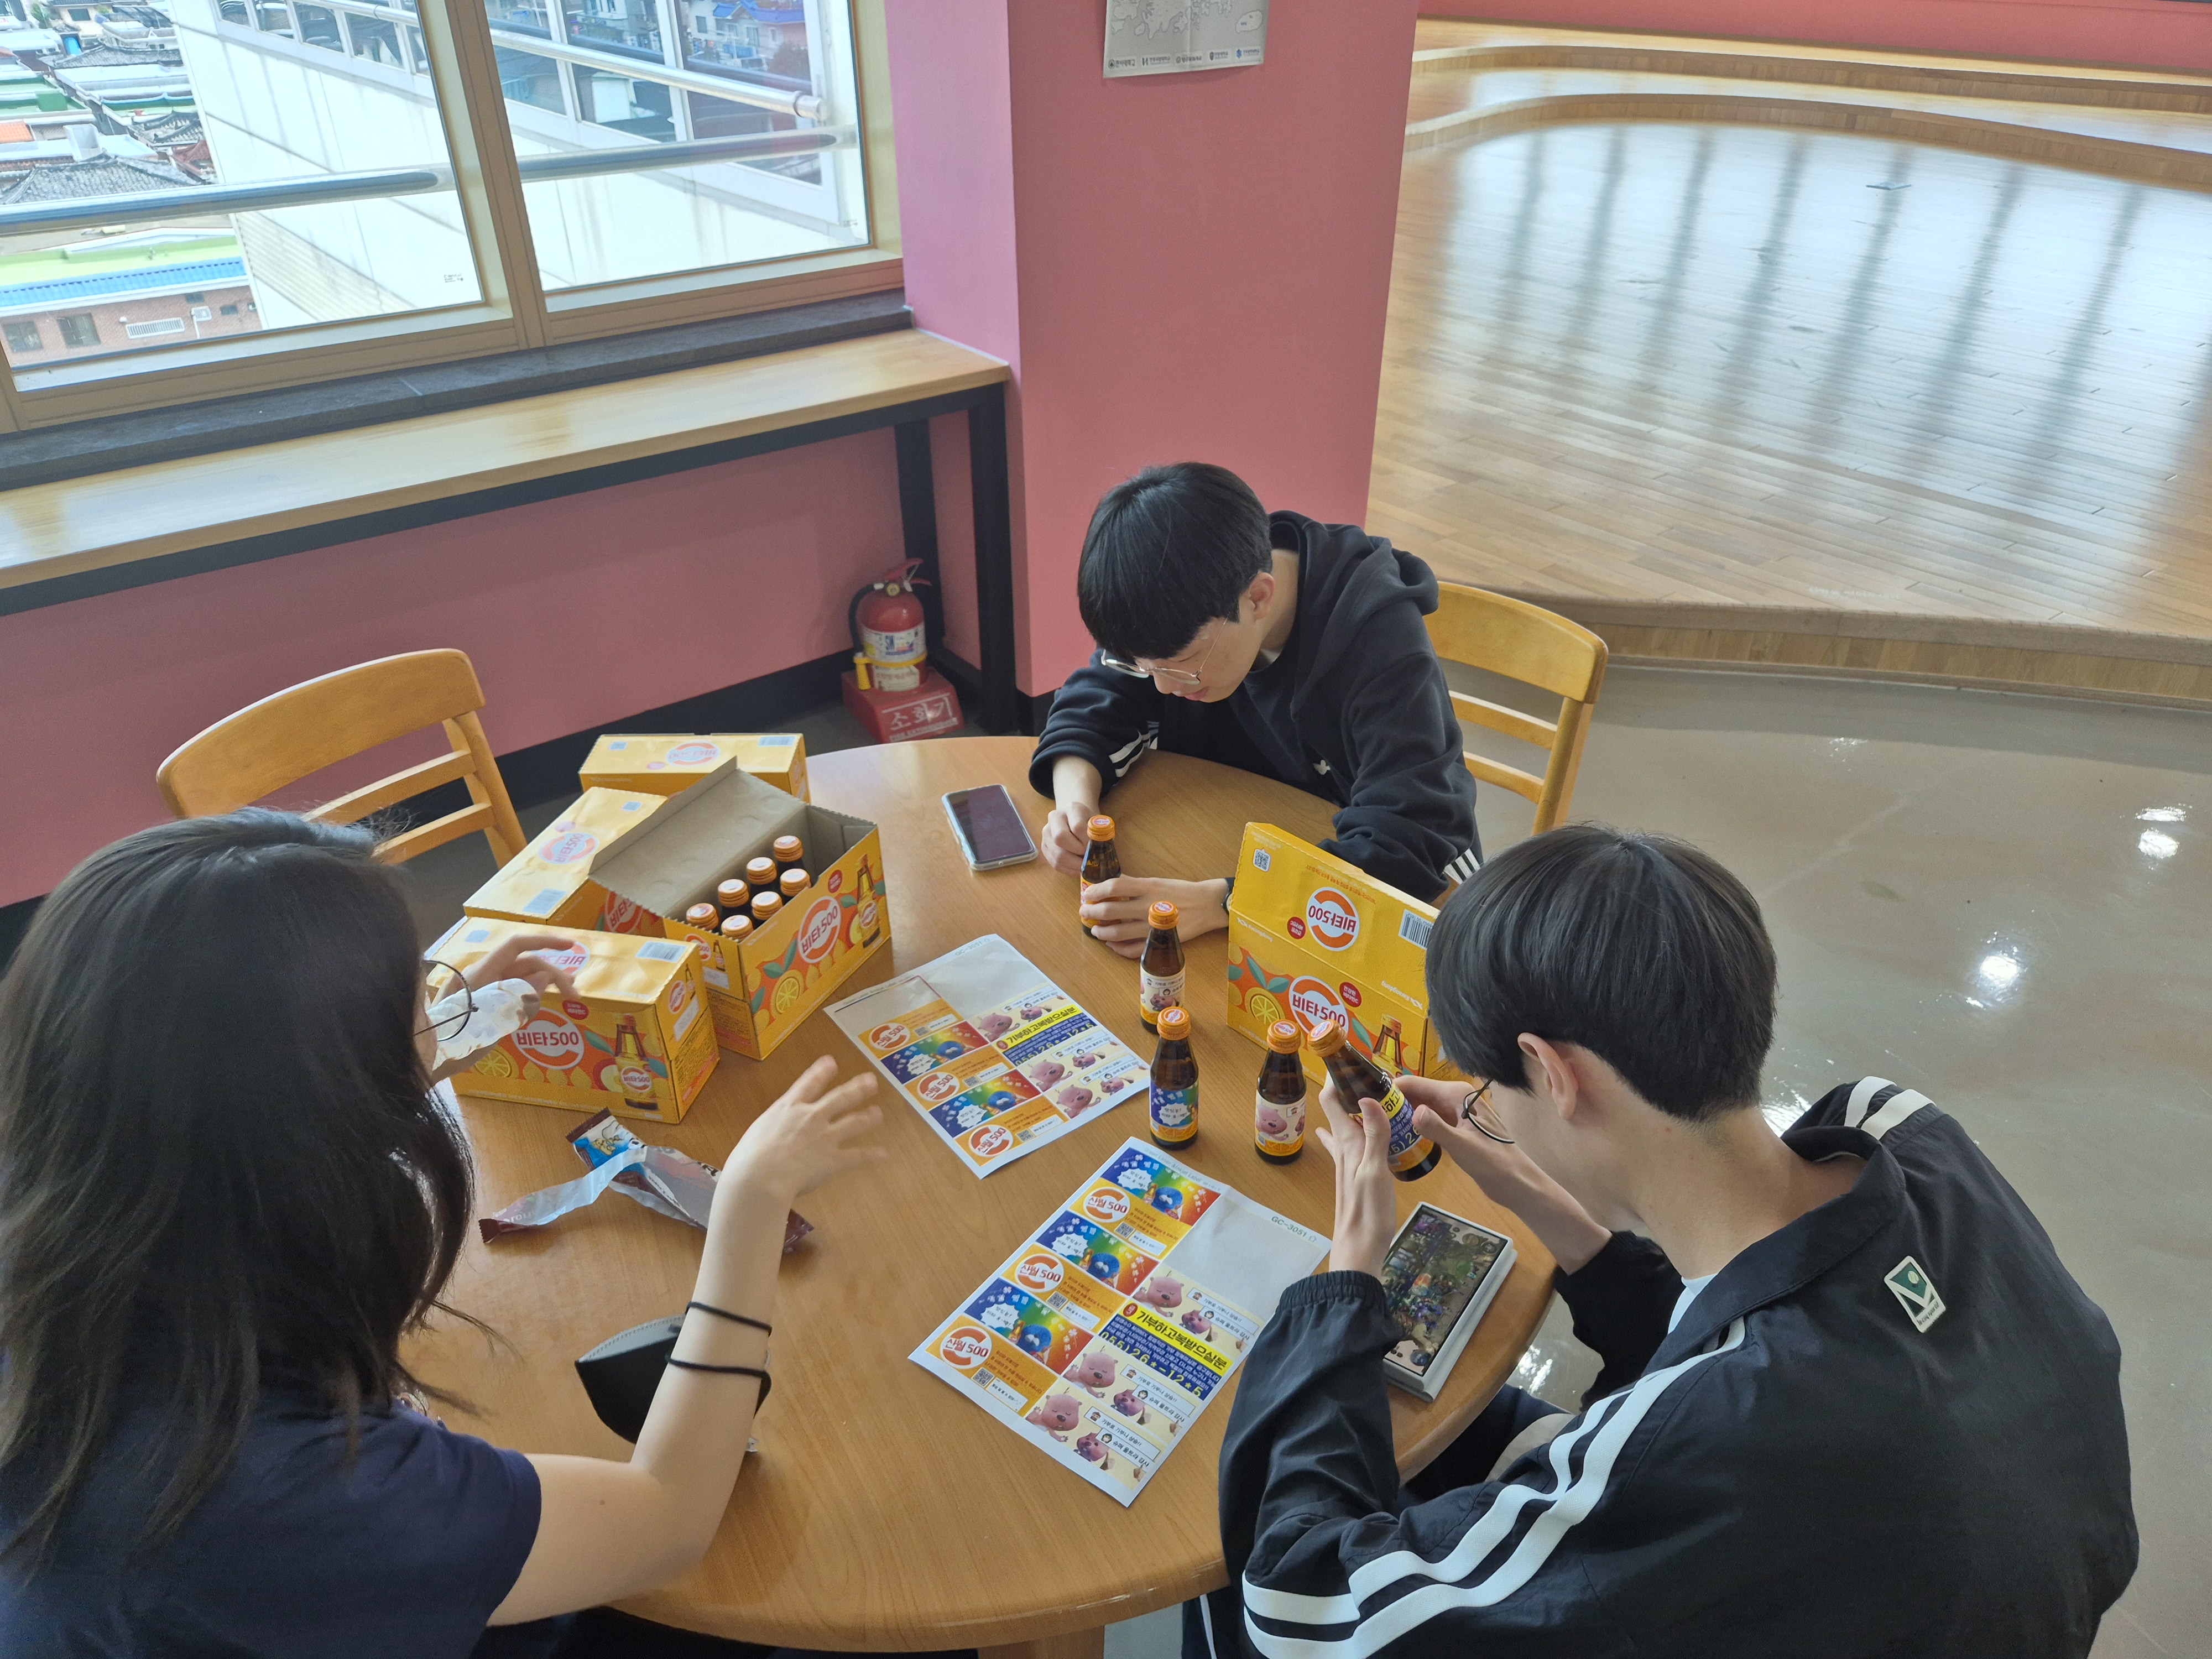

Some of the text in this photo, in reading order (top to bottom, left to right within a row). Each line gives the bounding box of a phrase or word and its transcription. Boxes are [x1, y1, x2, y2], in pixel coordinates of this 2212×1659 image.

[890, 697, 952, 731] 소화기
[802, 905, 838, 953] 비타500
[1308, 905, 1357, 932] 비타500
[1343, 992, 1359, 1004] 비타민C
[1292, 994, 1346, 1027] 비타500
[889, 1025, 905, 1037] 500
[1006, 1006, 1077, 1044] 기부하고복받으실분
[517, 1031, 579, 1046] 비타500
[937, 1074, 954, 1087] 500
[1382, 1092, 1401, 1113] 하고
[977, 1127, 1006, 1153] 신월 500
[1088, 1196, 1128, 1214] 신월 500
[1271, 1216, 1307, 1237] GC-3051
[1021, 1264, 1062, 1283] 신월 500
[945, 1337, 989, 1358] 신월 500
[1136, 1311, 1228, 1370] 기부하고복받으실분
[1123, 1446, 1138, 1460] 울트라
